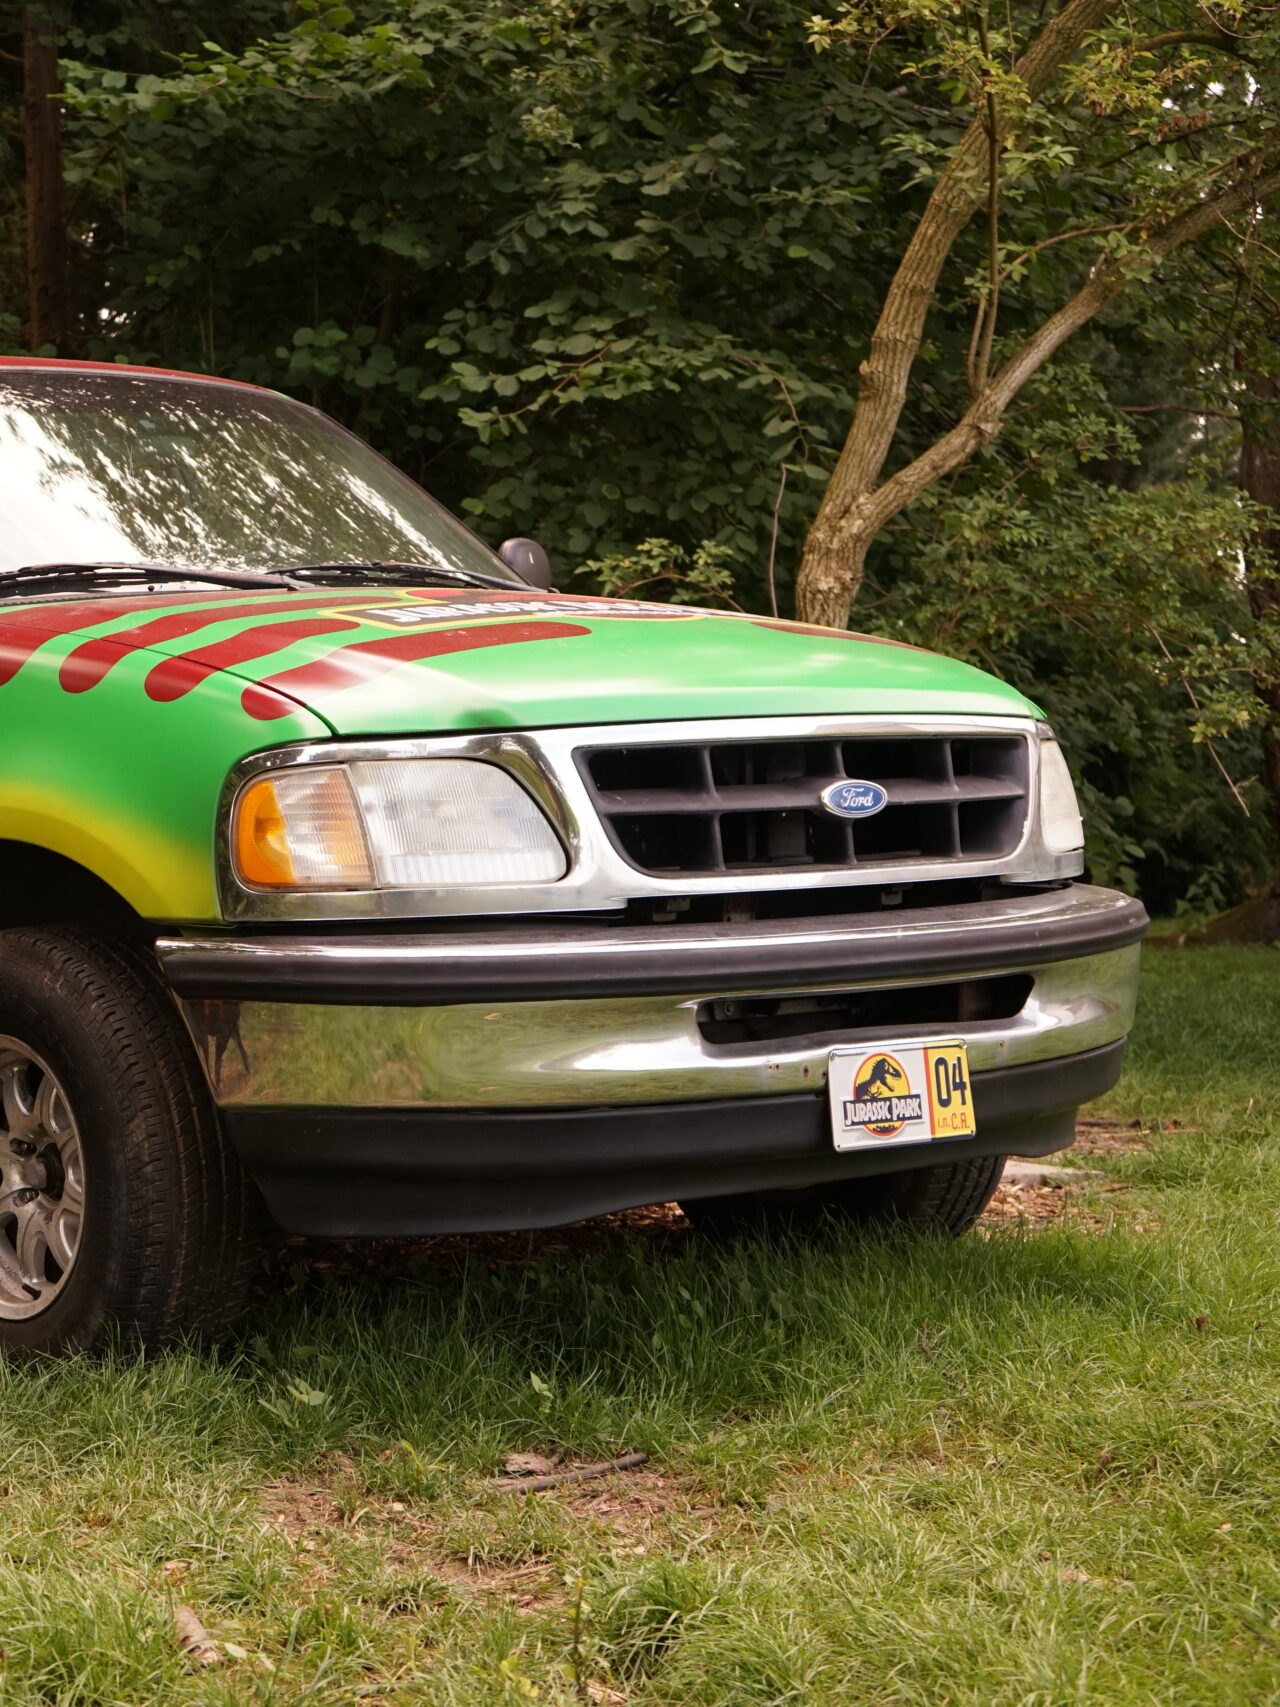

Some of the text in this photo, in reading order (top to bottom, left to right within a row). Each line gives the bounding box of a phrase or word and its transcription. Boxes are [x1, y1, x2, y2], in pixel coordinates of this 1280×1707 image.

[841, 788, 874, 807] Ford
[934, 1056, 967, 1108] 04
[845, 1098, 922, 1126] JURASSIC PARK
